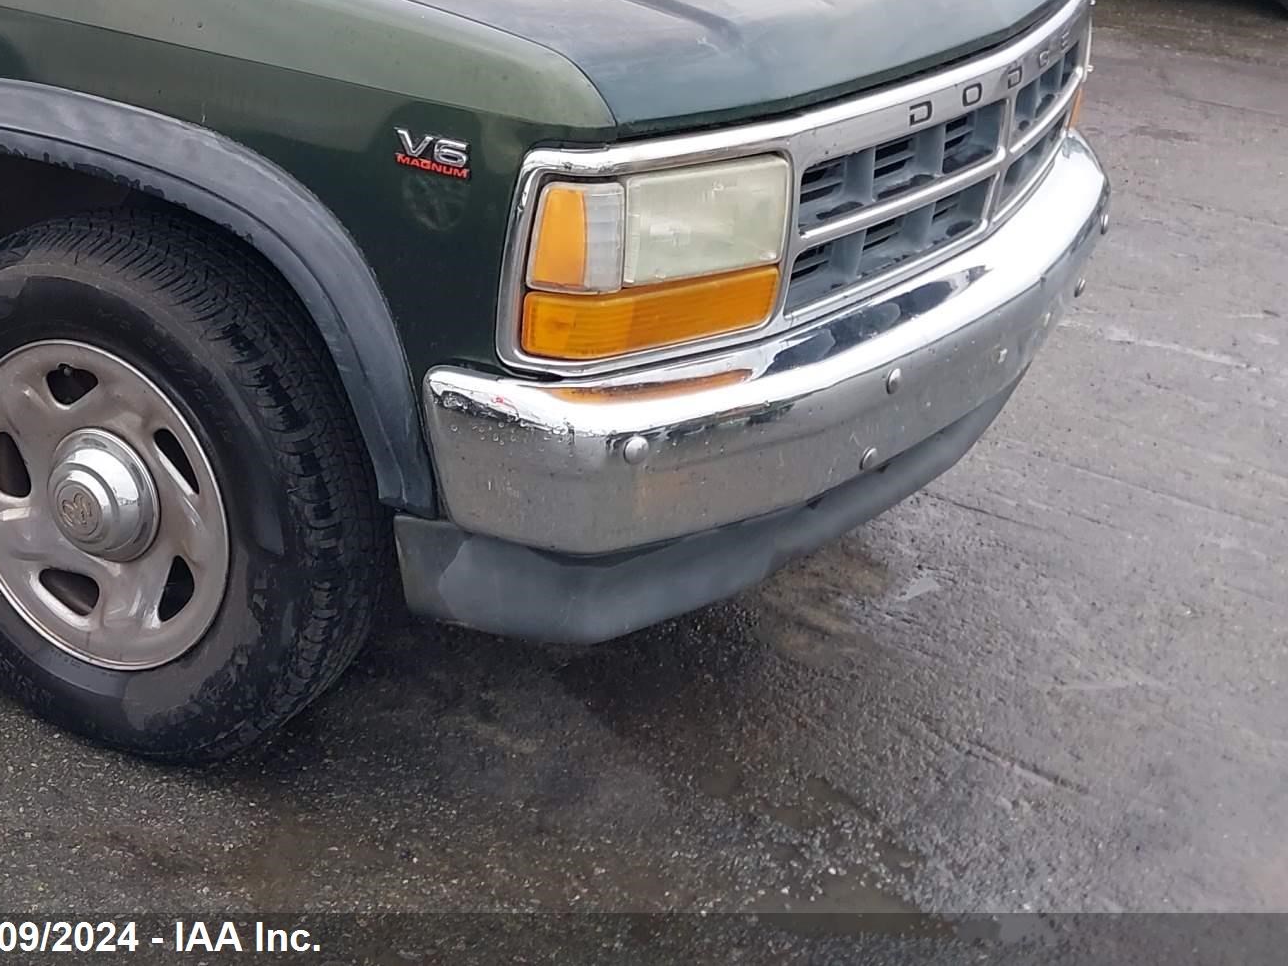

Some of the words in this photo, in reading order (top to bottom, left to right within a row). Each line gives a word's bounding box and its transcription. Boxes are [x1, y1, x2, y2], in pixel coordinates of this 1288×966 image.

[909, 32, 1069, 126] DODGE
[394, 126, 469, 167] V6
[395, 152, 469, 179] MAGNUM
